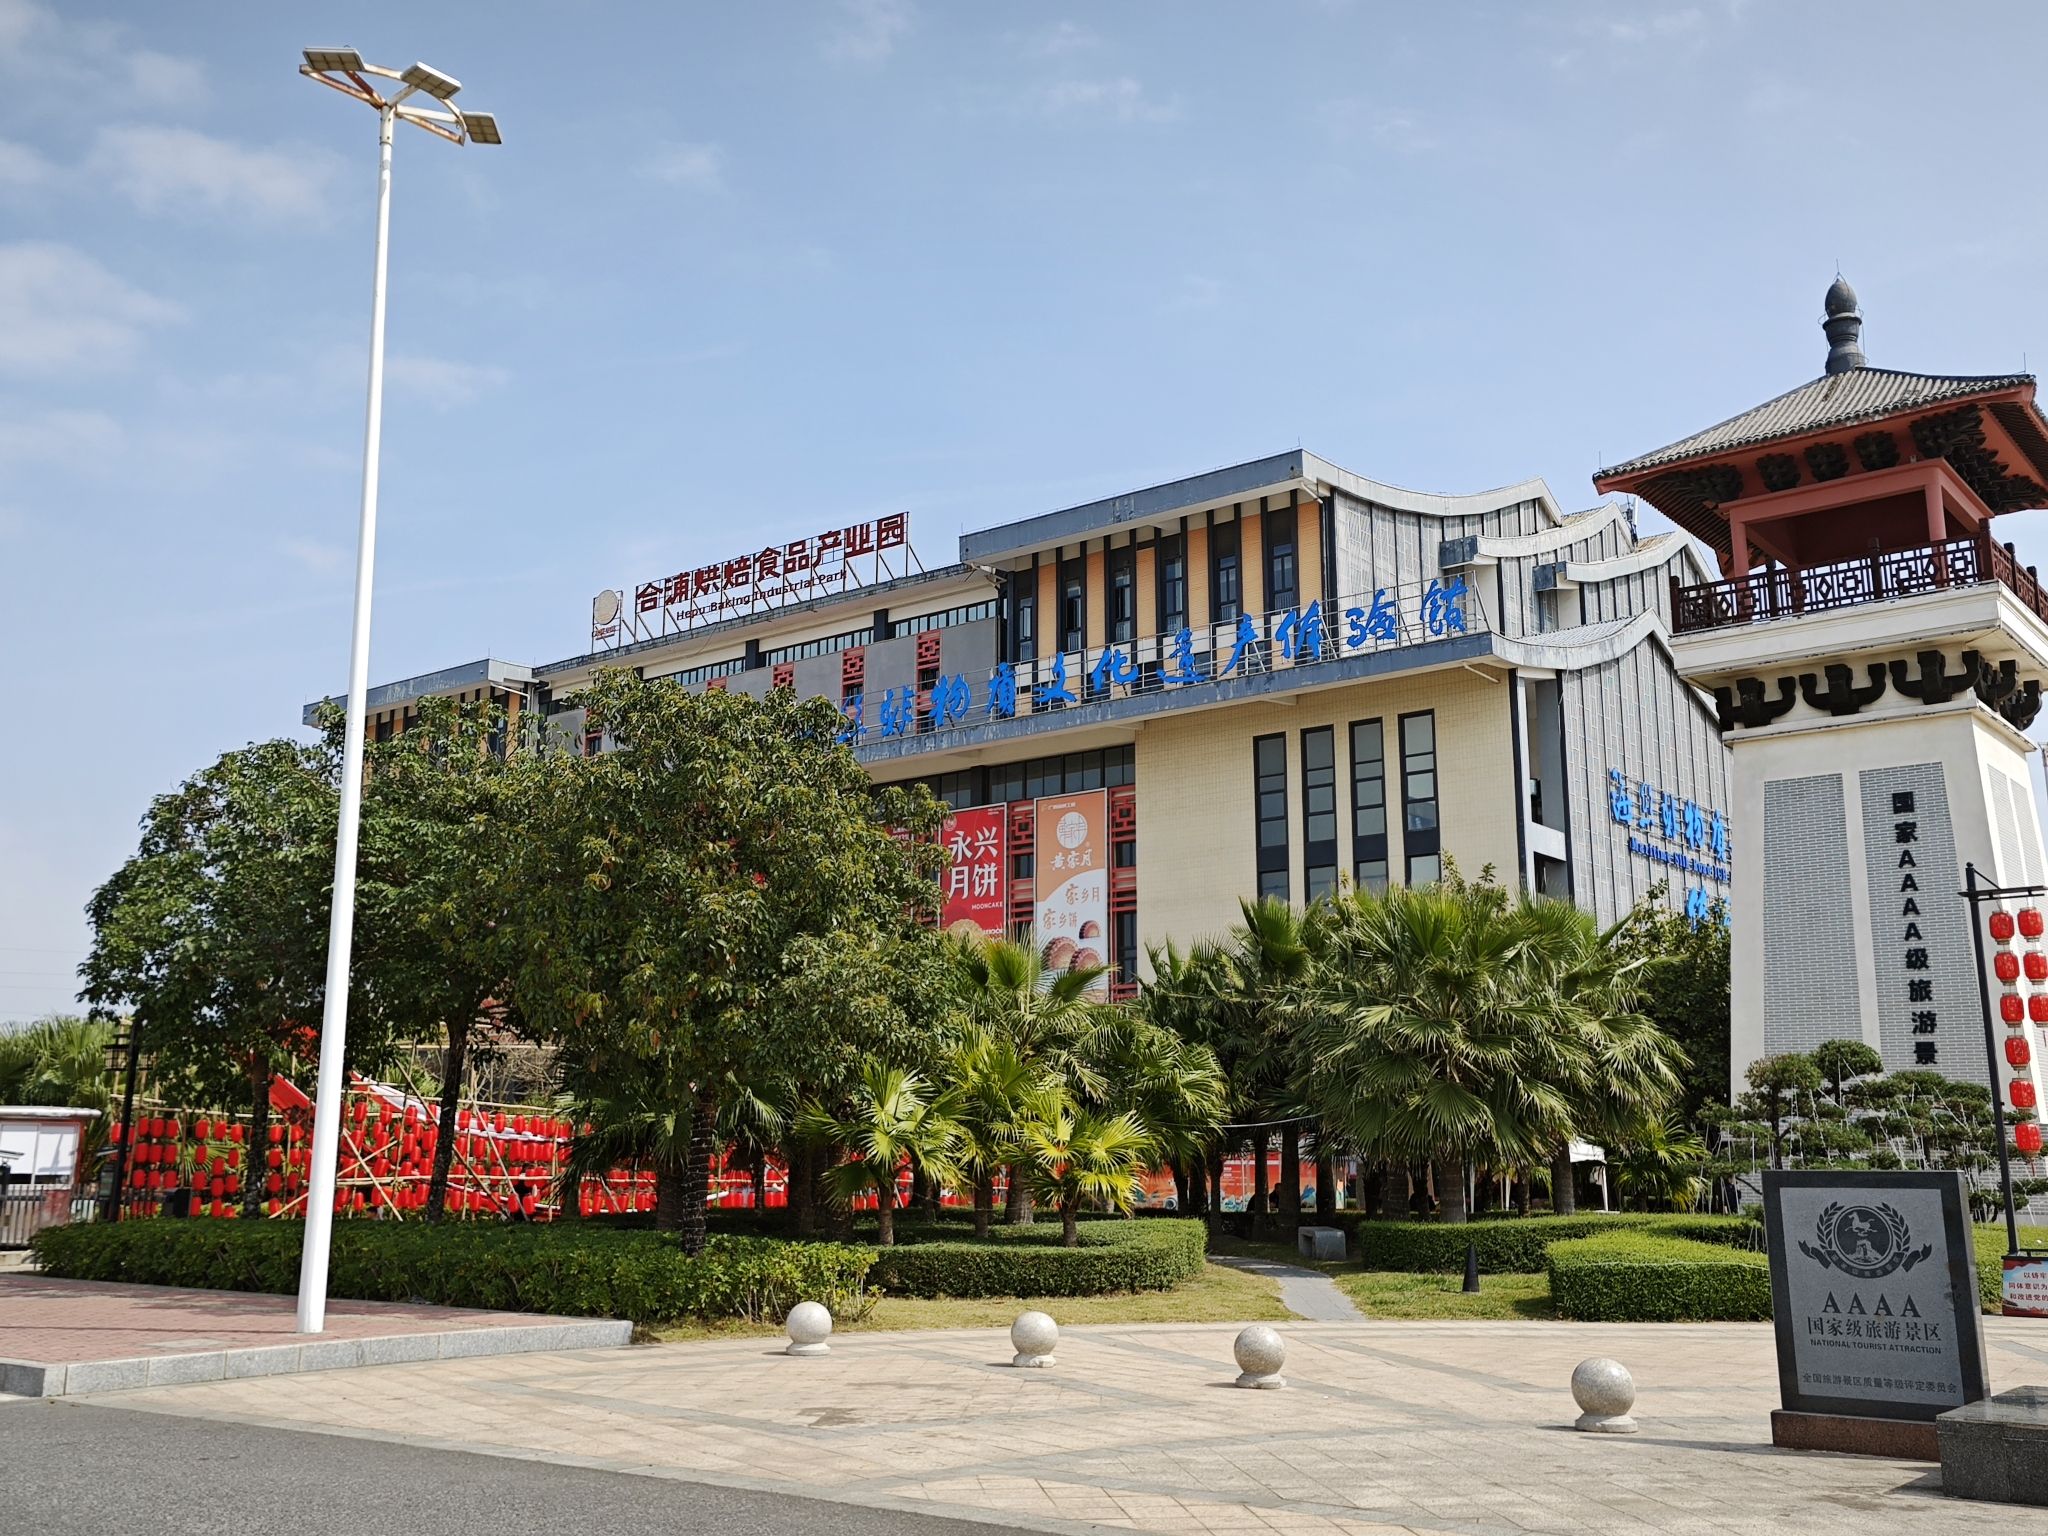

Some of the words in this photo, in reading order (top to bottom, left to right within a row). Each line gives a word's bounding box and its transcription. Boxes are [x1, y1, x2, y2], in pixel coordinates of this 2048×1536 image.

[636, 513, 906, 613] 合浦烘焙食品产业园
[676, 606, 706, 621] Hepu
[710, 593, 750, 611] Baking
[753, 577, 814, 601] Industrial
[818, 569, 847, 586] Park
[948, 826, 998, 863] 永兴
[948, 862, 998, 899] 月饼
[971, 901, 1003, 910] MOONCAKE
[1892, 791, 1938, 1065] 国家AAAA级旅游景
[1807, 1316, 1942, 1342] 国家级旅游景区
[1810, 1339, 1850, 1349] NATIONAL
[1853, 1341, 1887, 1351] TOURIST
[1889, 1344, 1942, 1354] ATTRACTION
[1802, 1372, 1957, 1394] 全国旅游景区质量等级评定委员会
